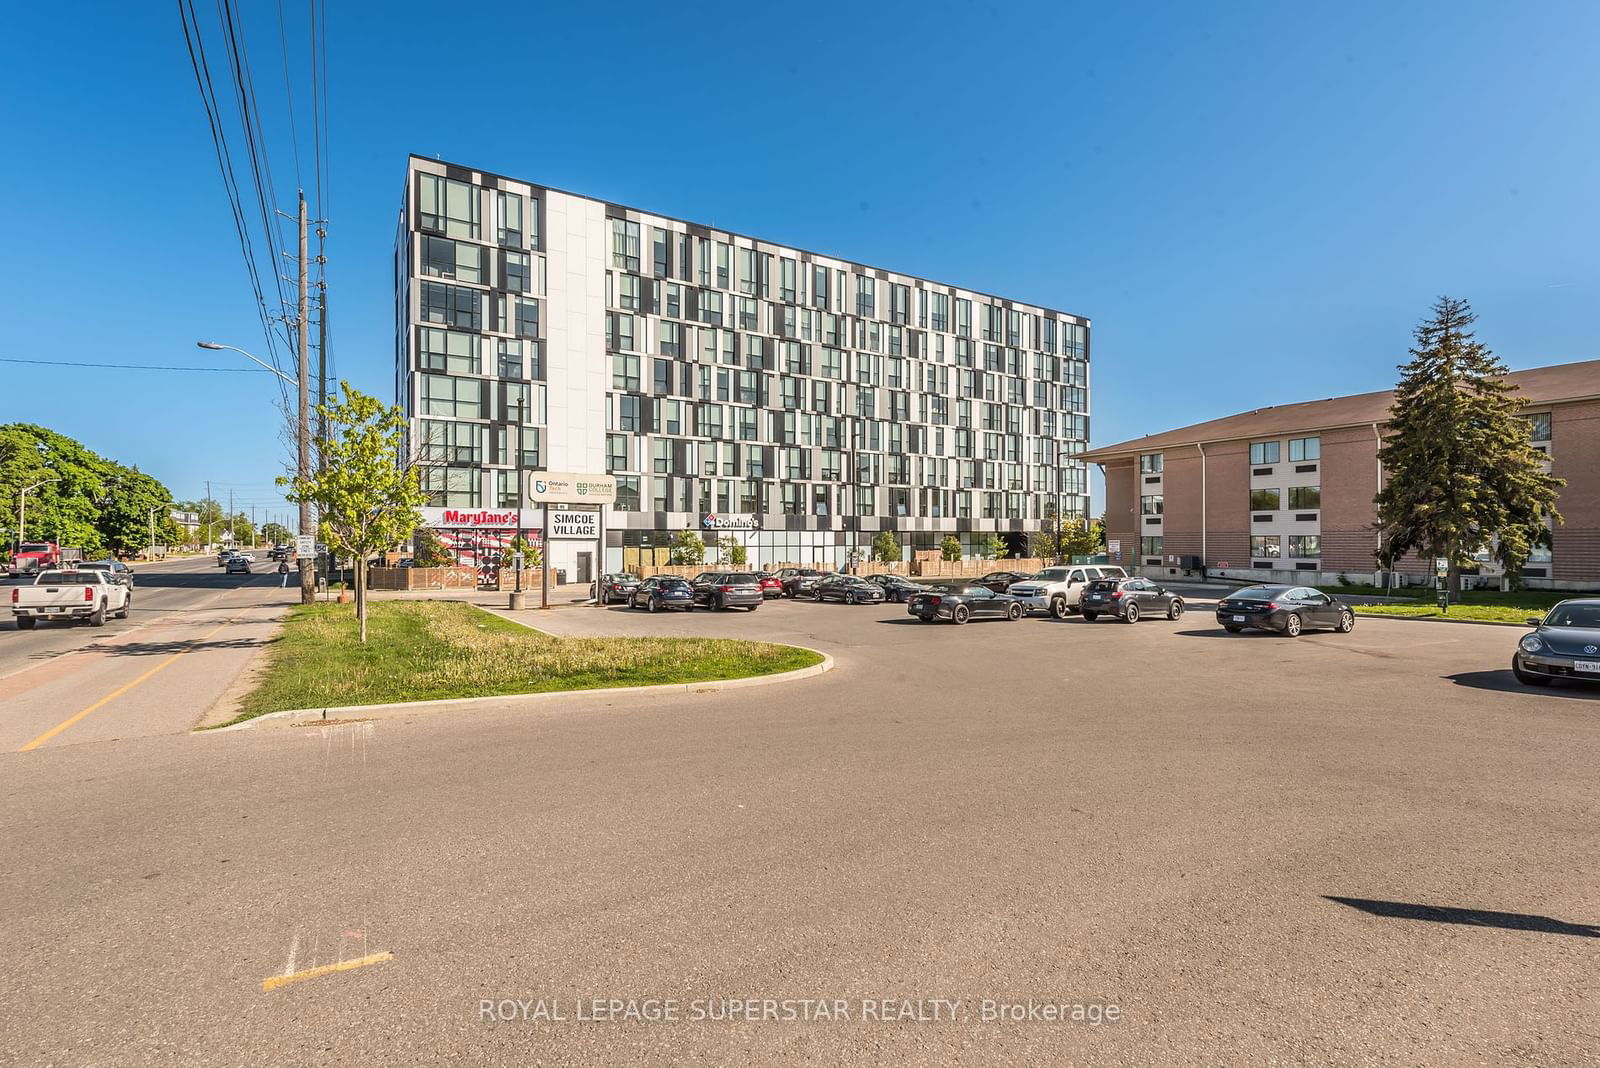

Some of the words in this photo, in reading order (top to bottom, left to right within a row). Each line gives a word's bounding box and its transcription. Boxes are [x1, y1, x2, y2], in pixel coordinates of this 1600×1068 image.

[445, 511, 518, 524] MaryJane's
[554, 514, 595, 524] SIMCOE
[716, 517, 759, 527] Domino's
[553, 526, 595, 535] VILLAGE
